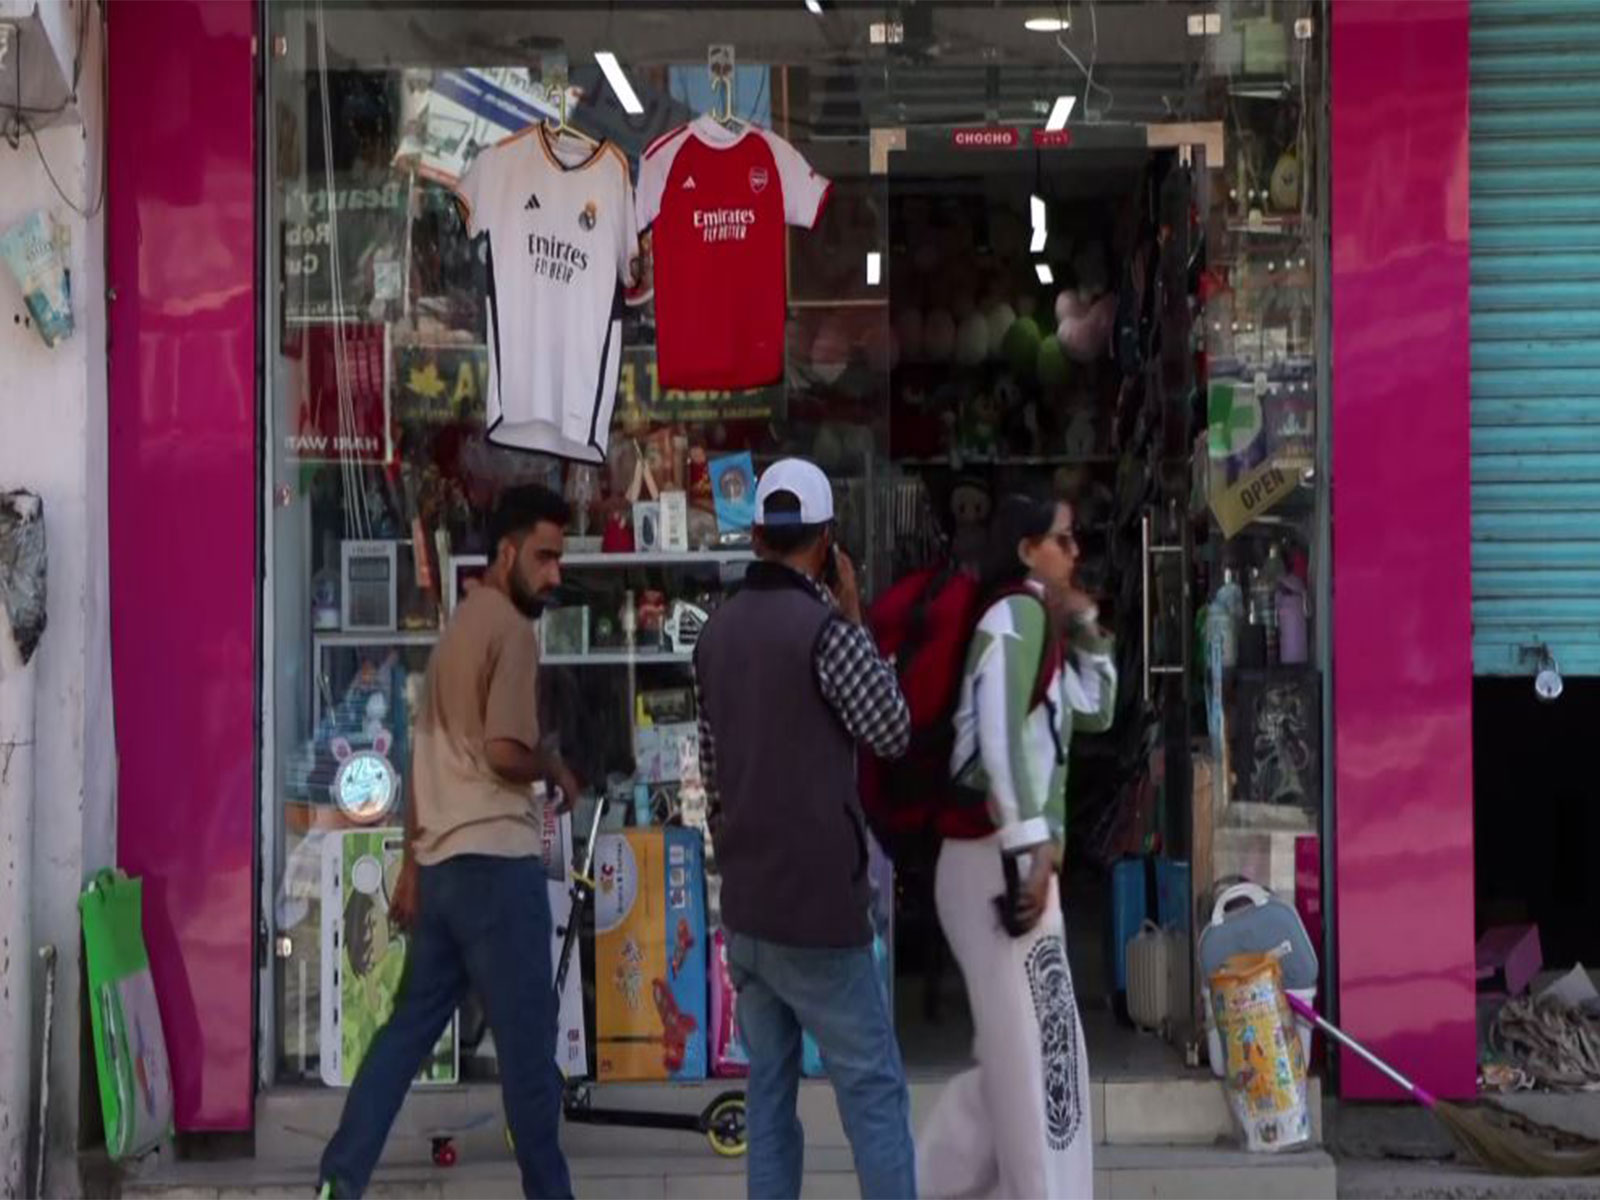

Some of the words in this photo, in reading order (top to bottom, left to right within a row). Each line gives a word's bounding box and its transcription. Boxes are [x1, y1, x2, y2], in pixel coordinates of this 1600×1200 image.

[955, 132, 1012, 145] CHOCHO
[693, 209, 755, 228] Emirates
[528, 233, 588, 271] Emirtes
[1240, 467, 1285, 510] OPEN
